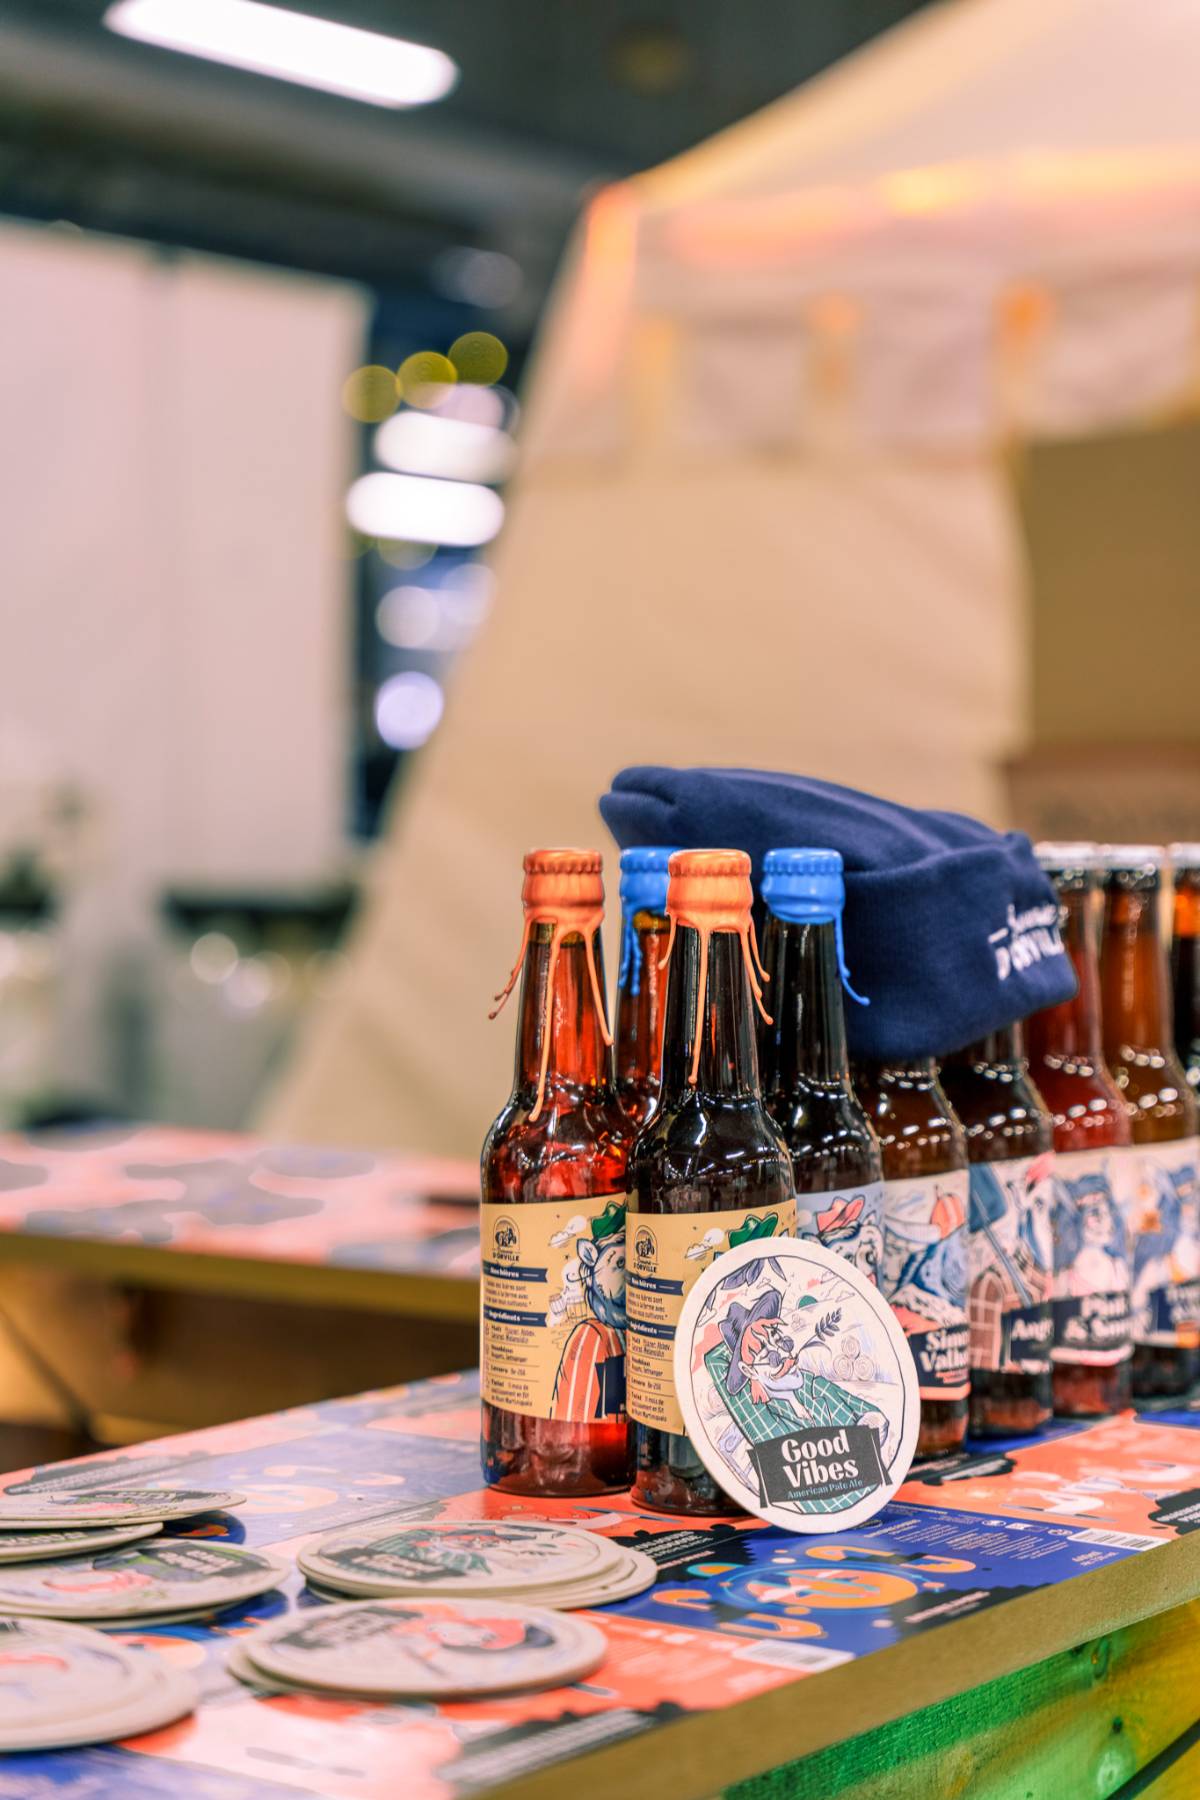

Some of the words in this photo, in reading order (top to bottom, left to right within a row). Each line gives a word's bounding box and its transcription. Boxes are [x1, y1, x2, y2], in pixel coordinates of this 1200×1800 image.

[781, 1429, 850, 1463] Good
[783, 1459, 859, 1488] Vibes
[788, 1485, 828, 1499] American
[829, 1482, 848, 1492] Pale
[849, 1479, 863, 1489] Ale
